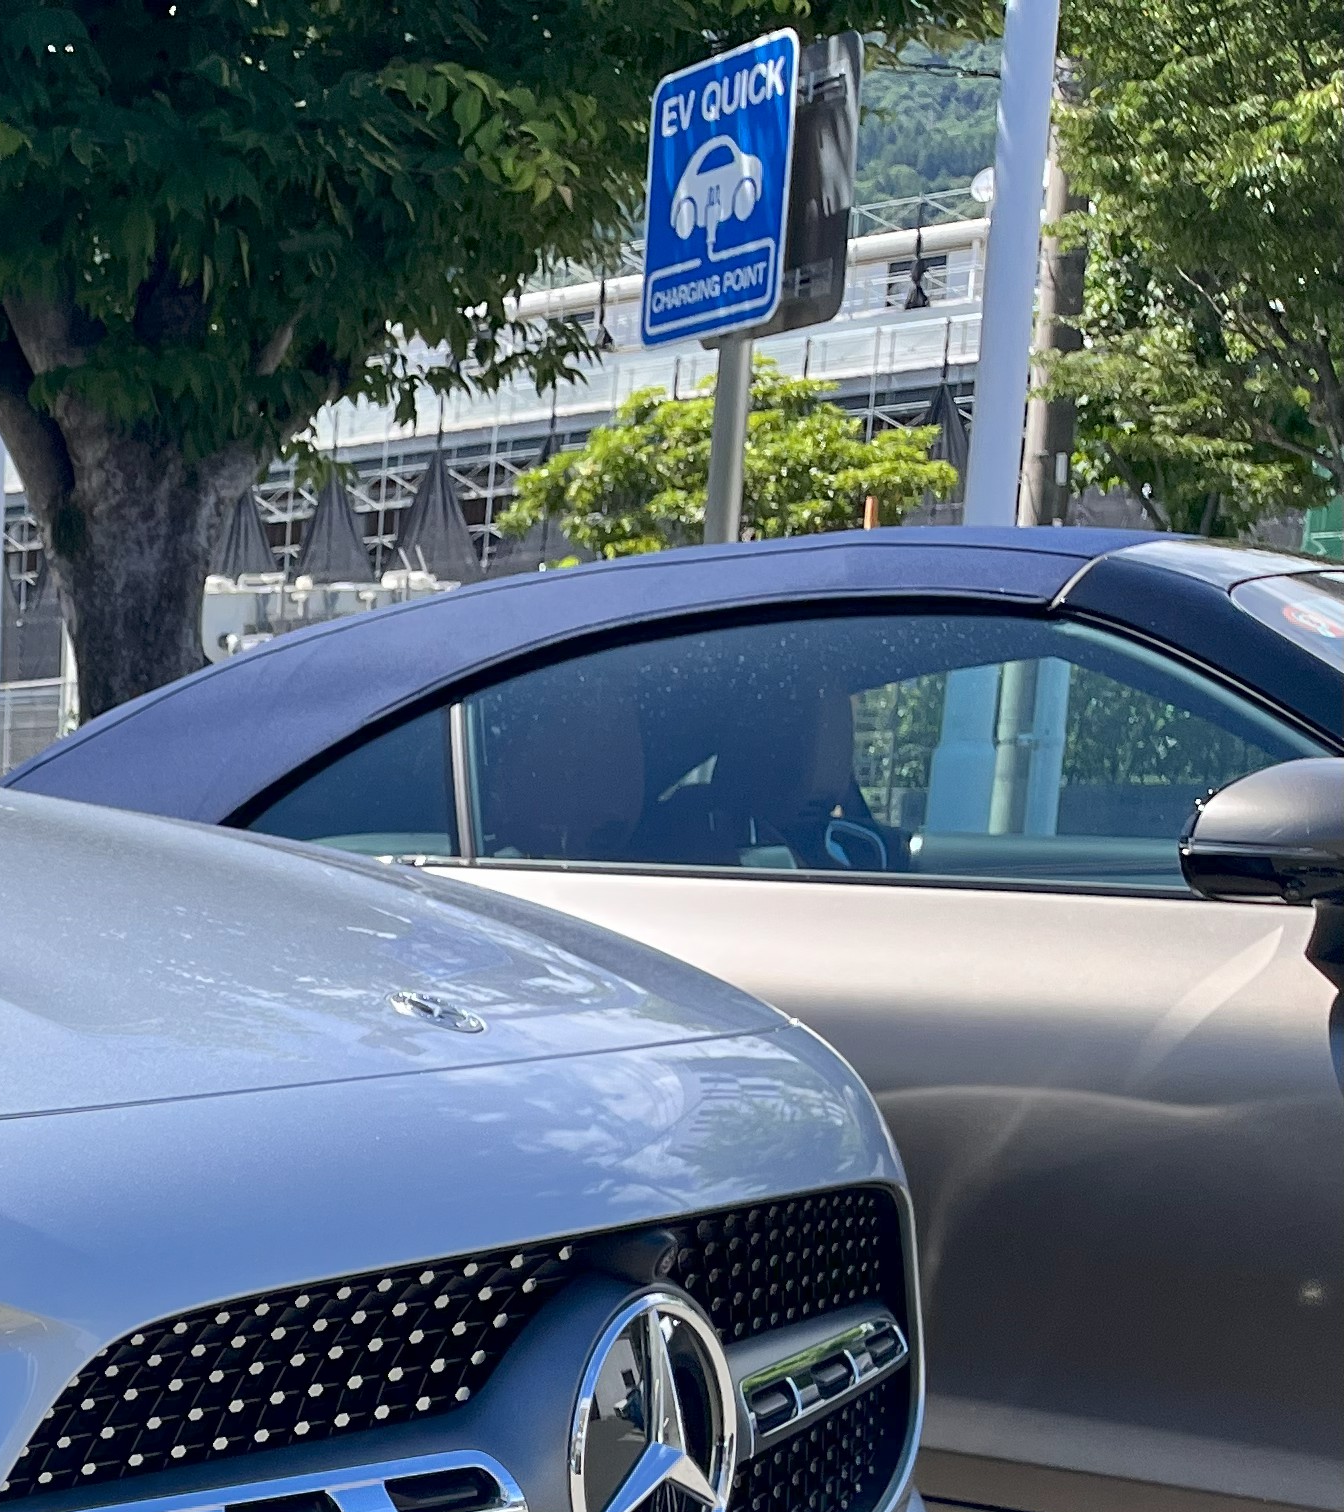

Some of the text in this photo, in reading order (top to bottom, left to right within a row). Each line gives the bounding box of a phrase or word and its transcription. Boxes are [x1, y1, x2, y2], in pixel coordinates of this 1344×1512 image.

[661, 56, 786, 138] EV QUICK
[652, 261, 768, 314] CHARGING POINT
